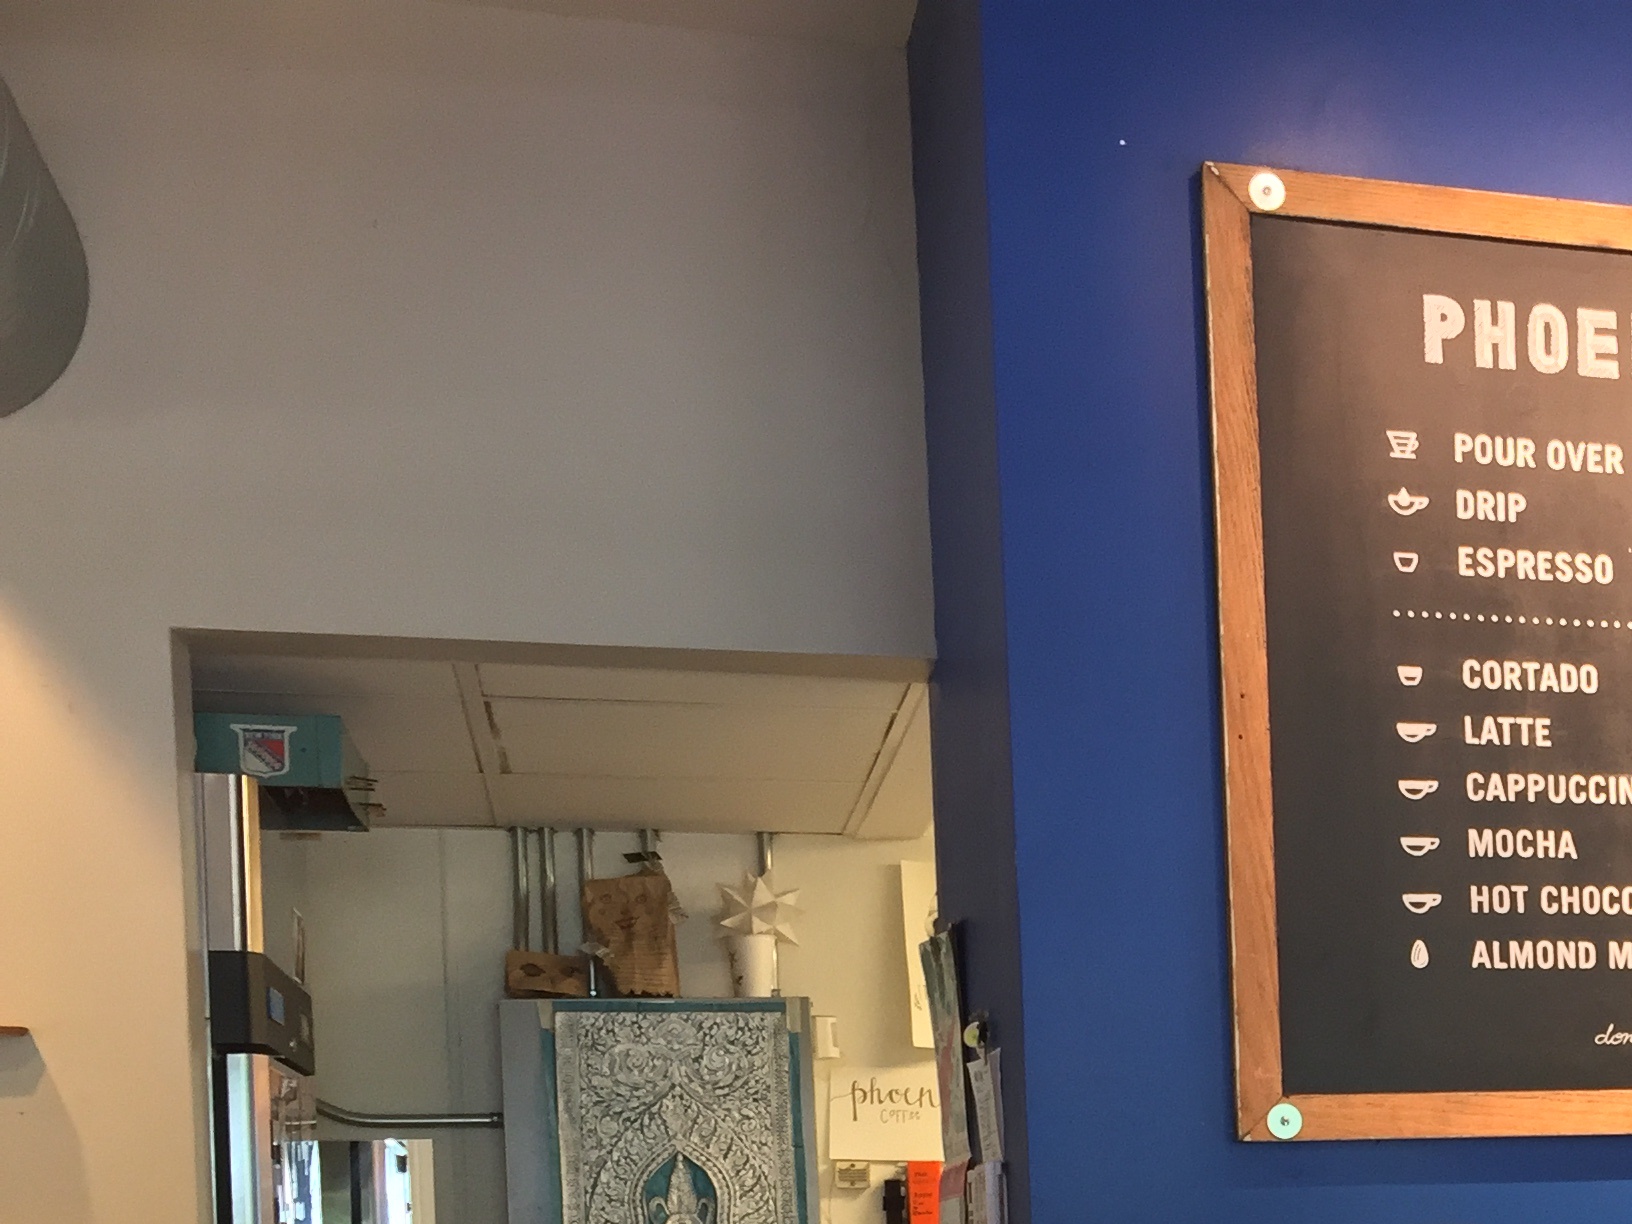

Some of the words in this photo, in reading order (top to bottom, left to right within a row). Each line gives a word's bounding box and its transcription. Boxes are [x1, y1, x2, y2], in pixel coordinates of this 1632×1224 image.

[1453, 432, 1537, 468] POUR
[1547, 439, 1625, 474] OVER
[1455, 488, 1527, 523] DRIP
[1457, 546, 1614, 585] ESPRESSO
[1462, 658, 1599, 694] CORTADO
[1463, 715, 1553, 748] LATTE
[1467, 829, 1579, 860] MOCHA
[1470, 885, 1529, 915] HOT
[1471, 940, 1597, 970] ALMOND
